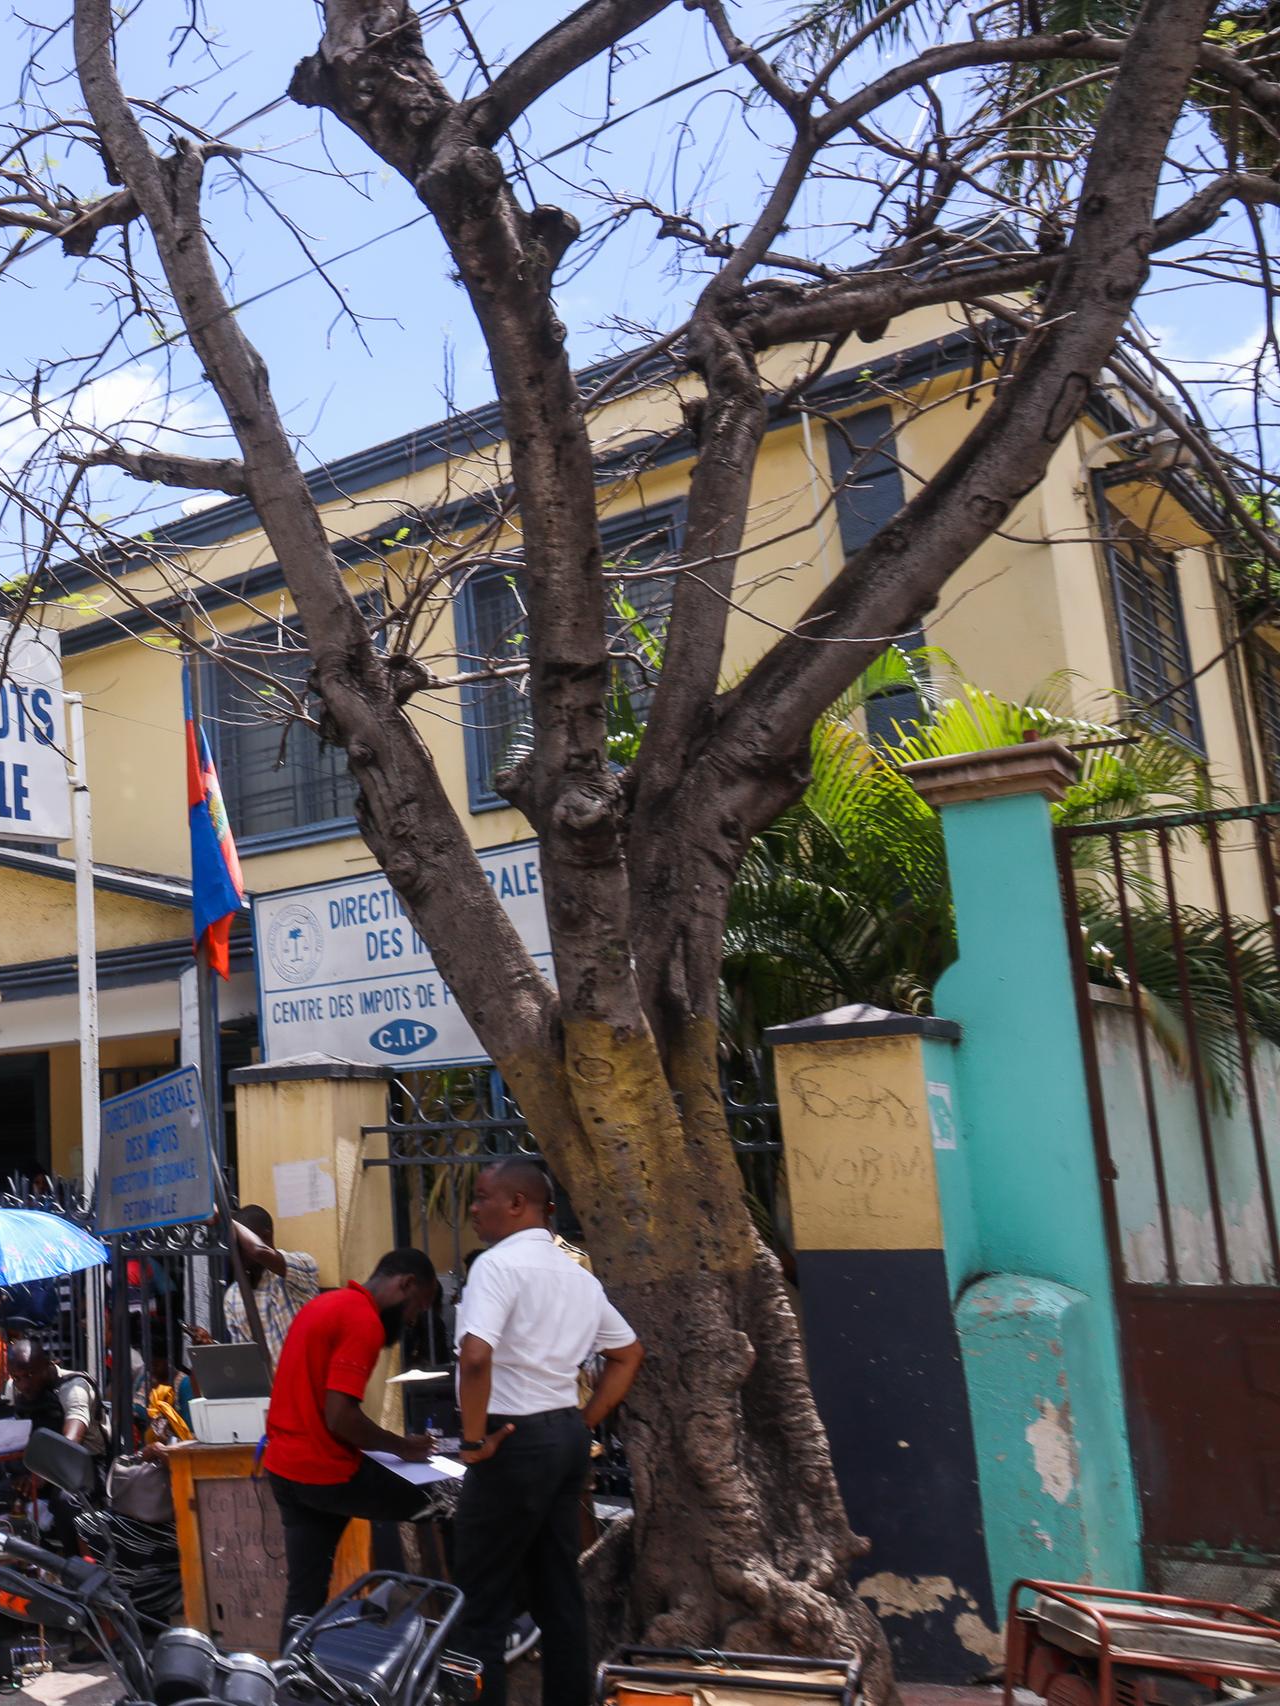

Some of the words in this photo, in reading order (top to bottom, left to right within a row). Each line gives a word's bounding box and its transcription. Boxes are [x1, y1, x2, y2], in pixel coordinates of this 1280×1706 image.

[366, 927, 404, 961] DES
[272, 998, 324, 1024] CENTRE
[329, 994, 355, 1018] DES
[359, 986, 412, 1015] IMPOTS
[417, 983, 437, 1008] DE
[378, 1026, 428, 1048] C.I.P
[125, 1134, 144, 1163] DES
